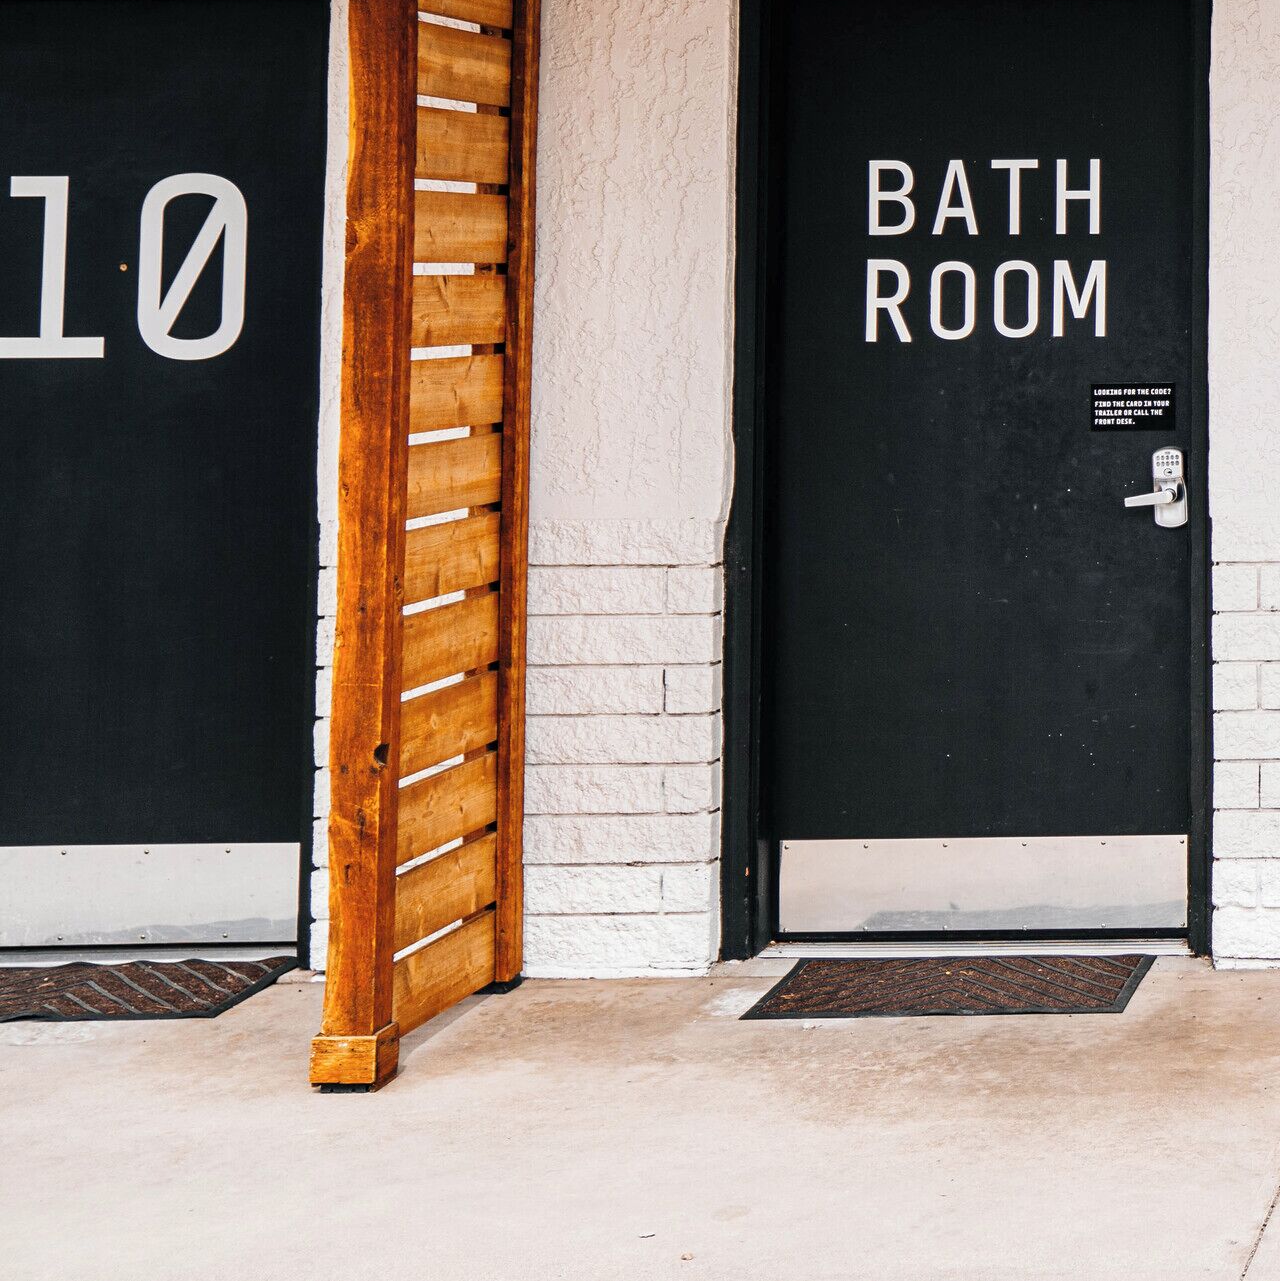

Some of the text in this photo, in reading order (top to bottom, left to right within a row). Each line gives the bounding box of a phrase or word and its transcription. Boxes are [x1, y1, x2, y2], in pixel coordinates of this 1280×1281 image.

[868, 158, 1102, 236] BATH
[0, 173, 248, 361] 10
[865, 258, 1107, 343] ROOM
